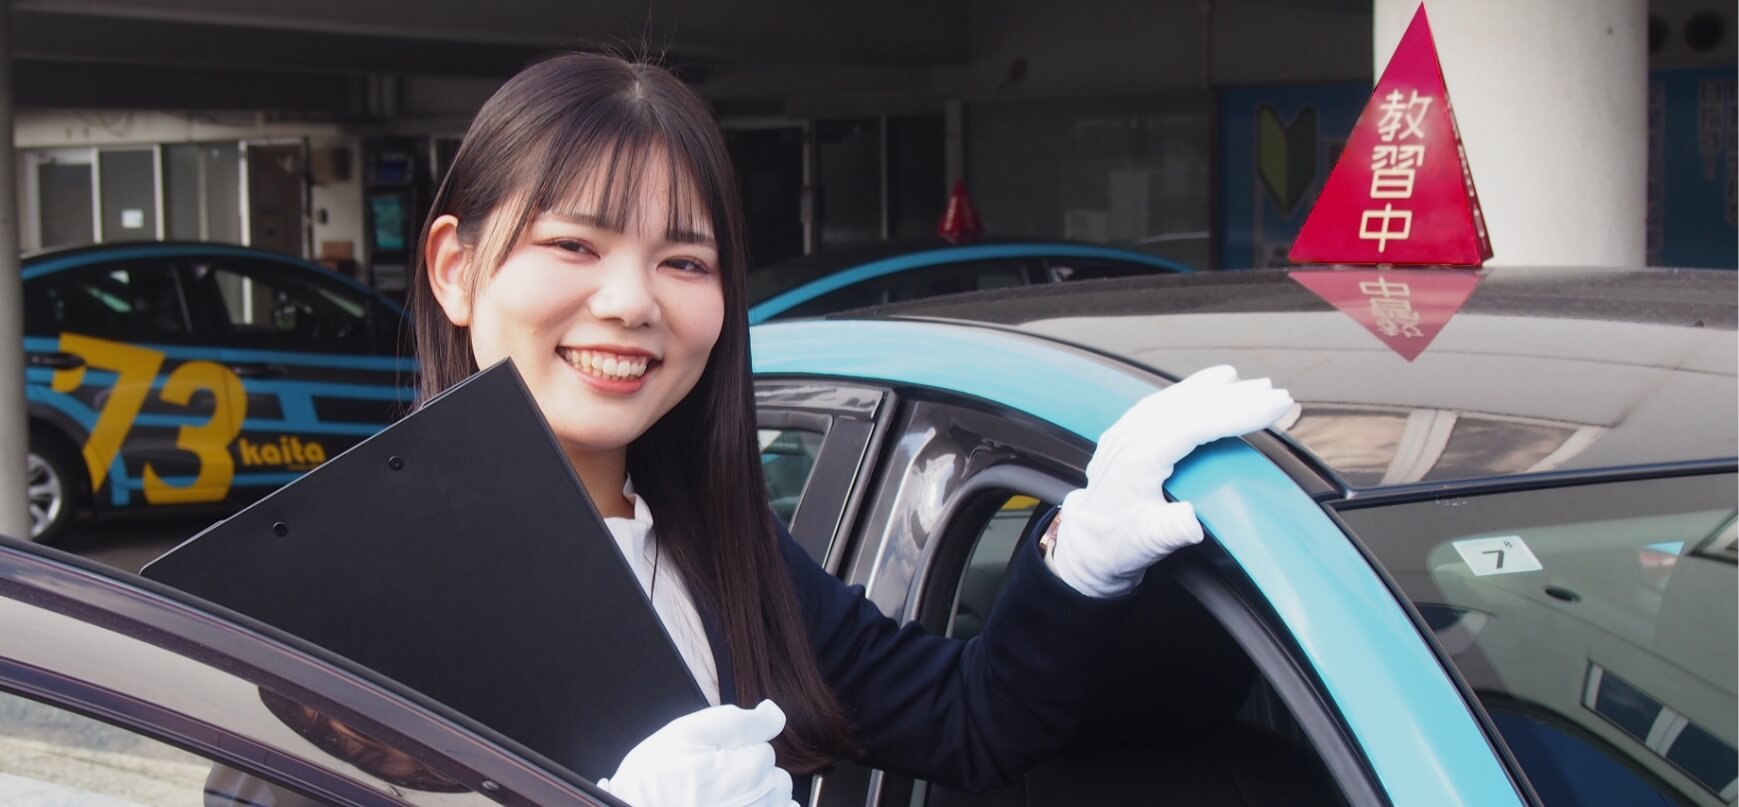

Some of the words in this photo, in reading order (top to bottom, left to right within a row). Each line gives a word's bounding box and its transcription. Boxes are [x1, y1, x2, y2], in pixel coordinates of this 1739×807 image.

[1359, 89, 1433, 253] 教習中
[239, 435, 326, 466] kaita
[1481, 549, 1504, 569] 7
